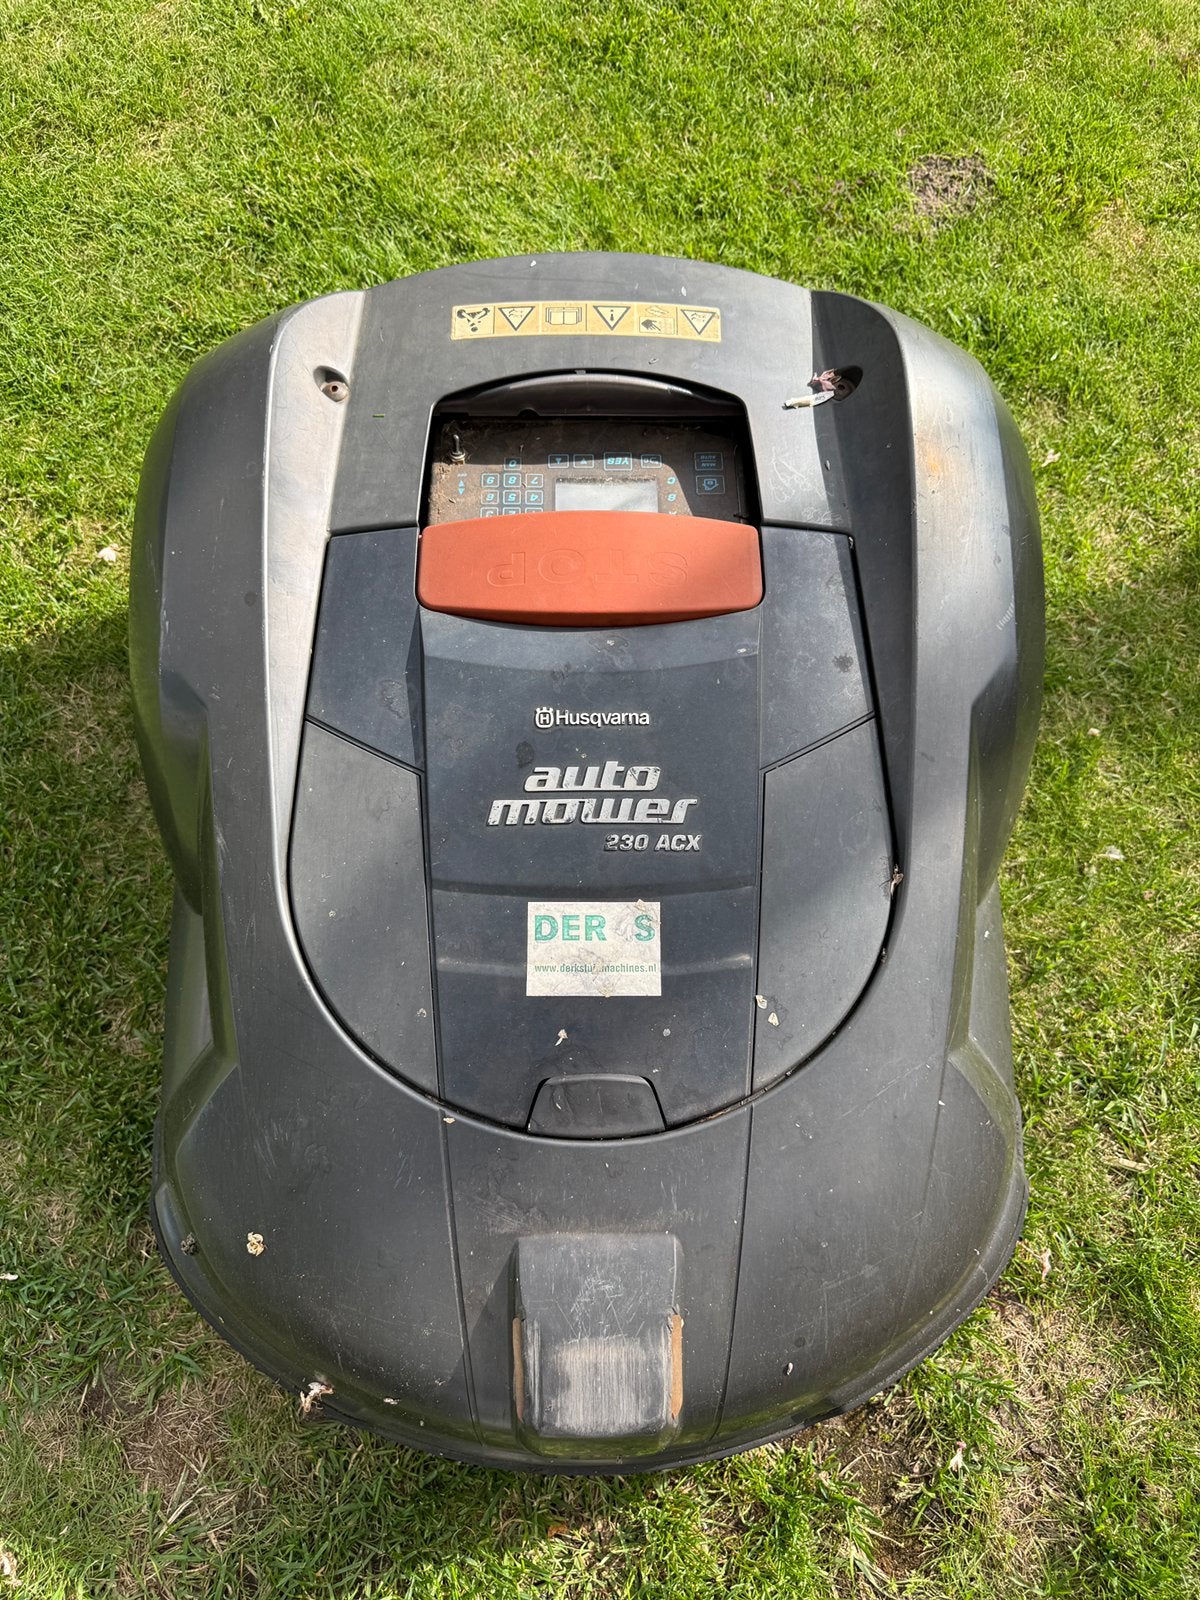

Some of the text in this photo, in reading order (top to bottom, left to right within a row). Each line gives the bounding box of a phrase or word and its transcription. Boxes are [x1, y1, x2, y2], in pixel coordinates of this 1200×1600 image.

[607, 457, 629, 465] YES
[487, 476, 495, 484] 9
[508, 476, 516, 484] 8
[531, 476, 538, 484] 7
[667, 477, 676, 485] C
[508, 493, 516, 501] 5
[487, 548, 688, 587] STOP
[556, 709, 650, 727] Husqvarna
[524, 761, 661, 791] auto
[487, 798, 698, 825] mower
[604, 834, 702, 851] 230 ACX
[534, 914, 656, 941] DERS
